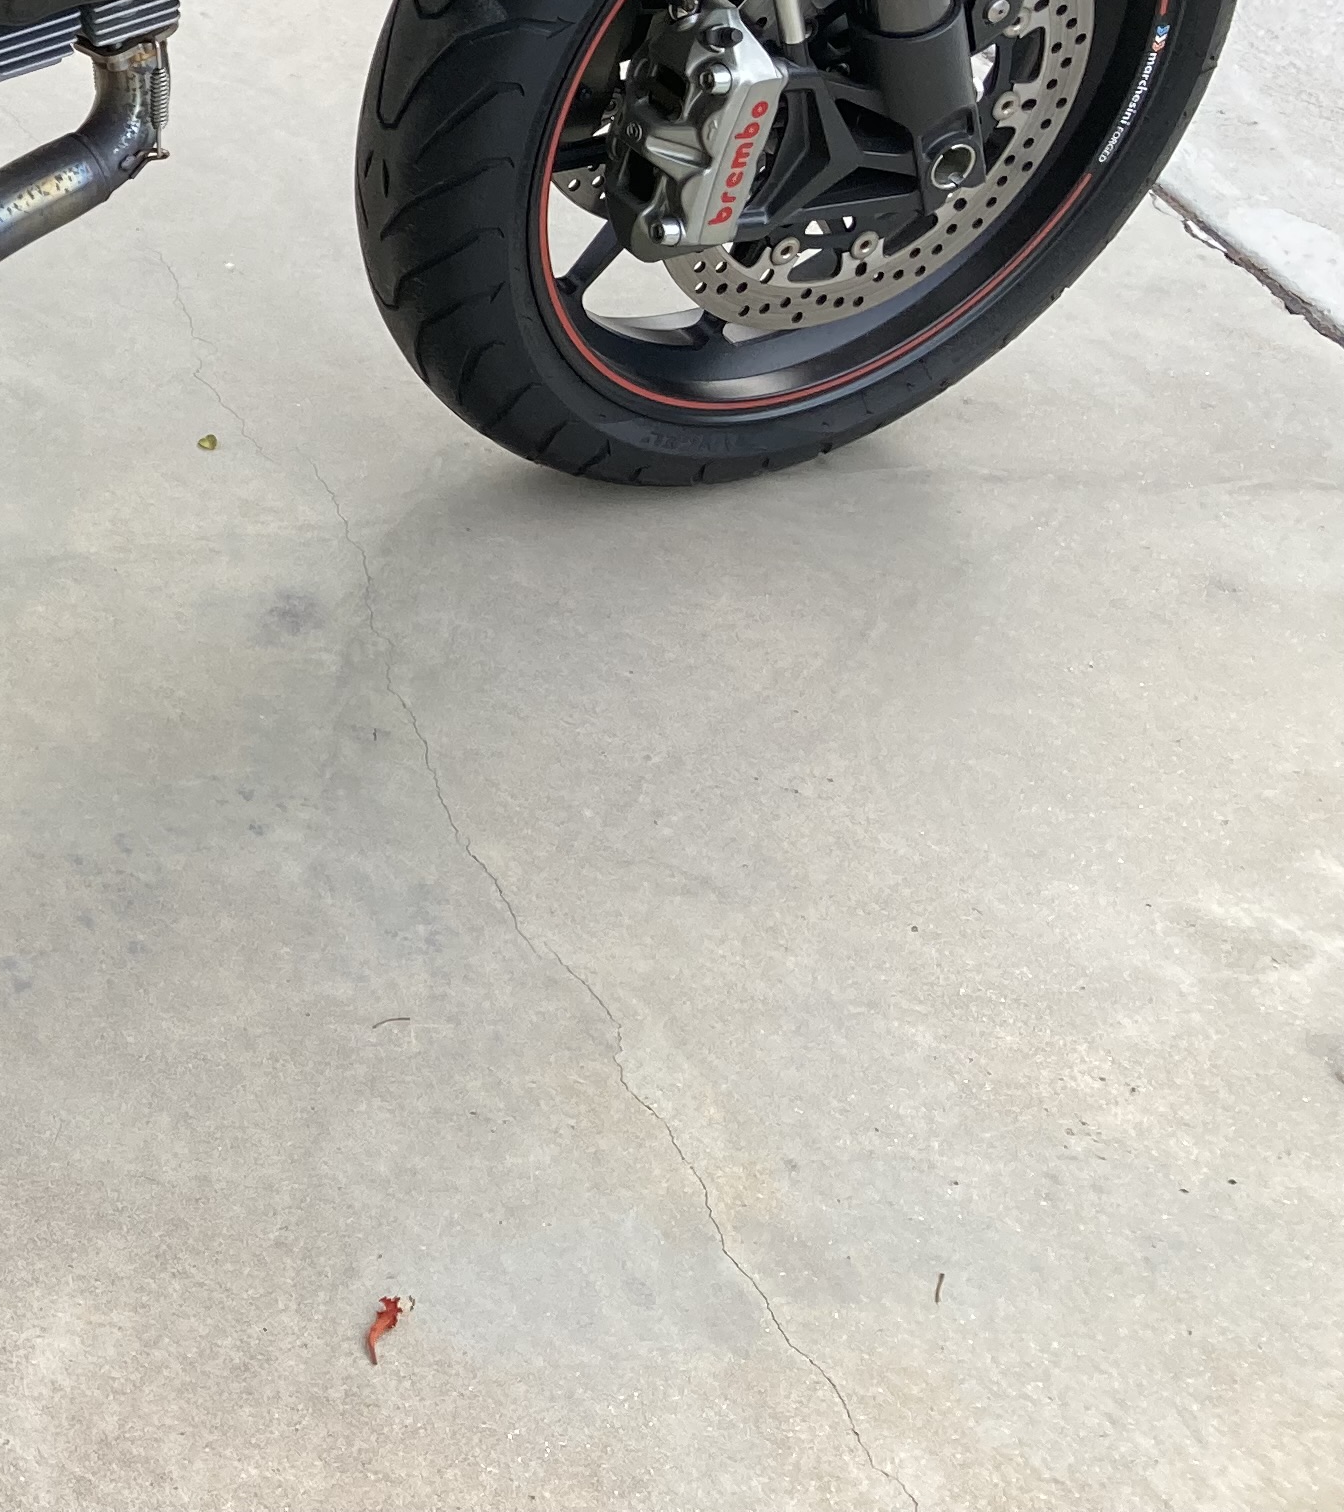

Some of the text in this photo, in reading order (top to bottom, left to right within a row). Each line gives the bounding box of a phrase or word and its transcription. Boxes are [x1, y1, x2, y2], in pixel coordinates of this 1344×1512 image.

[707, 100, 769, 226] brembo
[1098, 52, 1158, 163] marchesini FORGED
